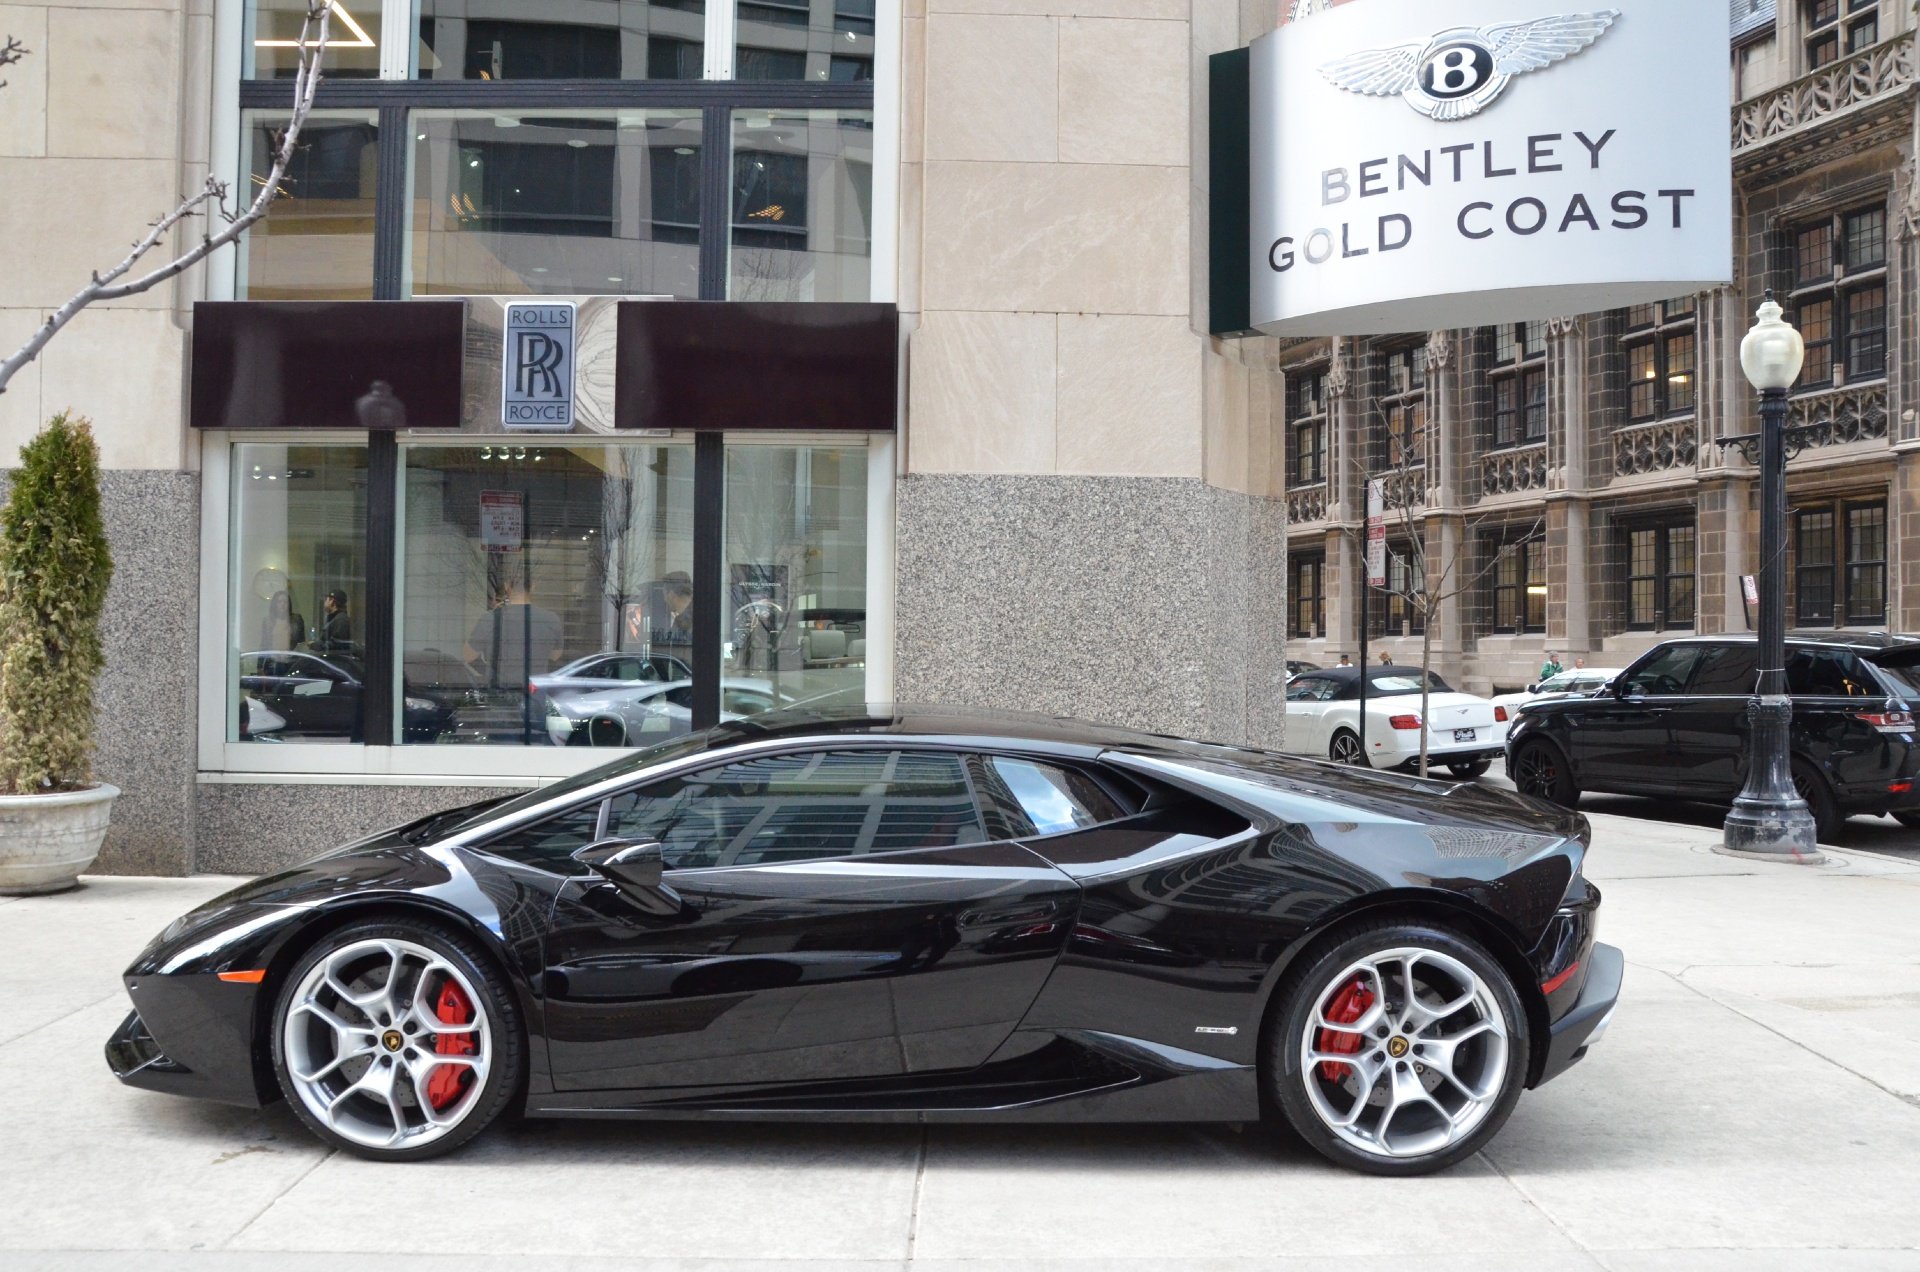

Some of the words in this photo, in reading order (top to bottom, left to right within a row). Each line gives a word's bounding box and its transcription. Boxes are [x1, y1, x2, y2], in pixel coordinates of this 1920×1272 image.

[1430, 46, 1479, 94] B
[1320, 129, 1617, 207] BENTLEY
[1268, 213, 1413, 272] GOLD
[1457, 189, 1695, 240] COAST
[512, 310, 568, 324] ROLLS
[509, 405, 565, 420] ROYCE
